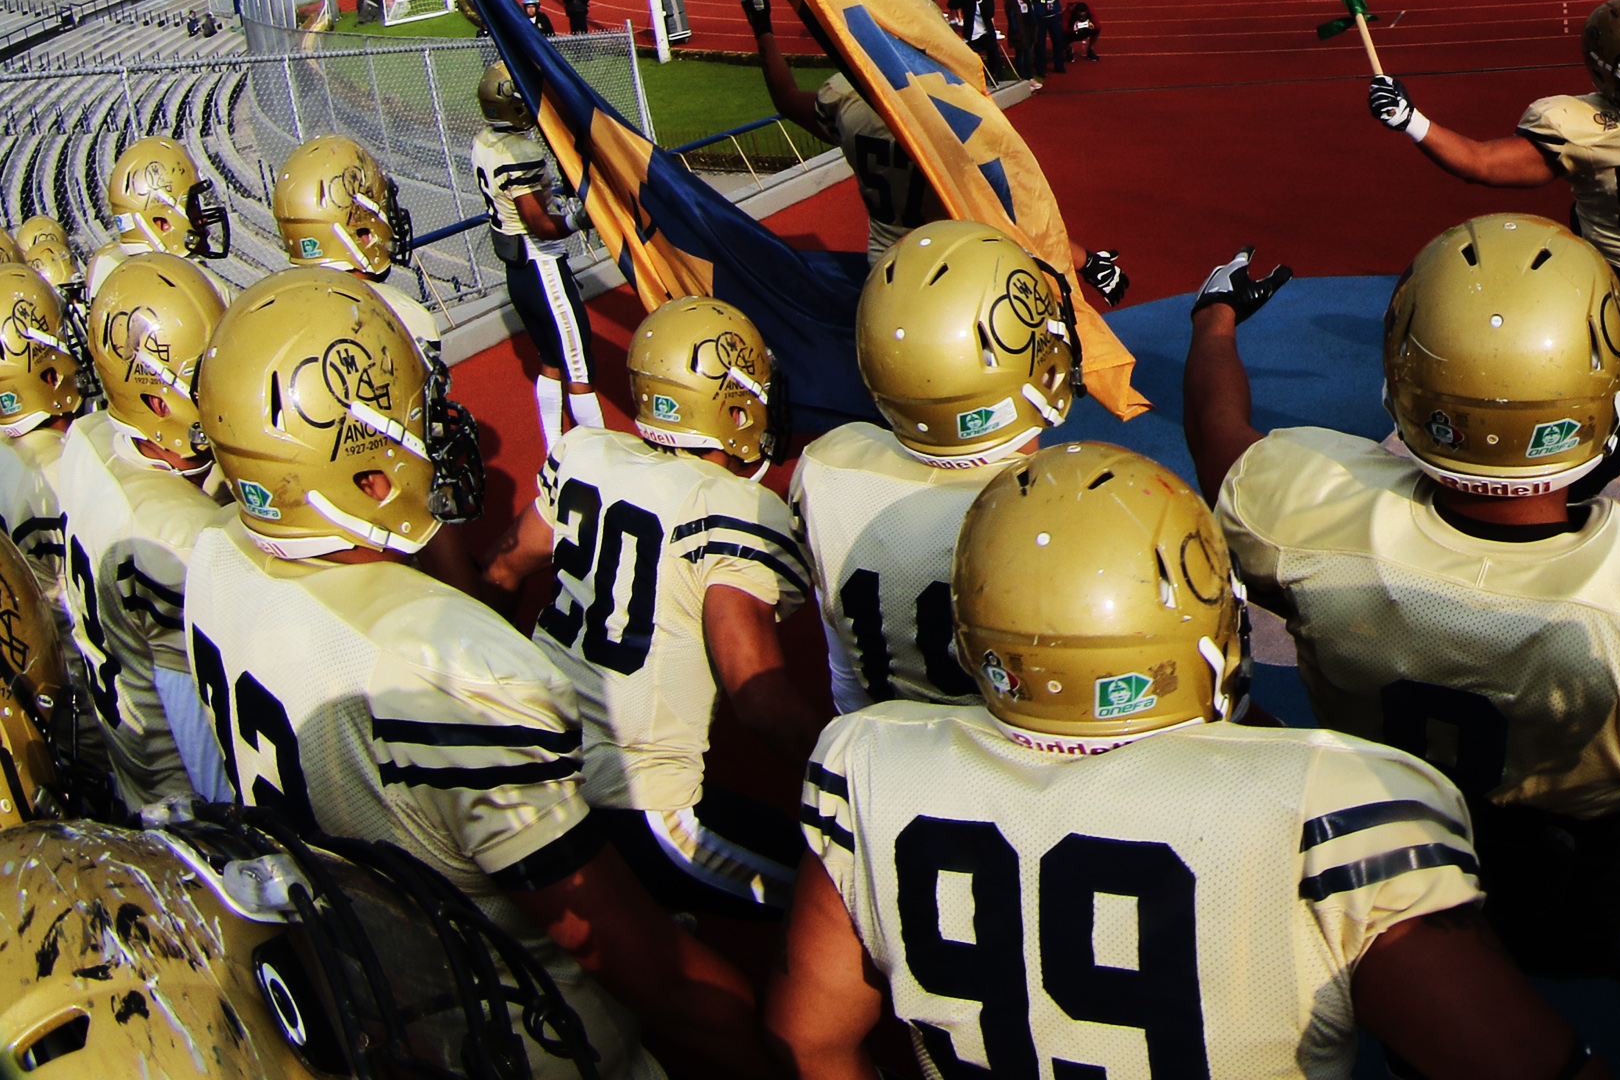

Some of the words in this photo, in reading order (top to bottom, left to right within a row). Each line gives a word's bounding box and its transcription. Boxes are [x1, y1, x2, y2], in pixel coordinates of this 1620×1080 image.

[344, 436, 390, 457] 1927-2017
[1440, 474, 1552, 496] Riddell
[537, 477, 664, 677] 20
[895, 814, 1211, 1080] 99
